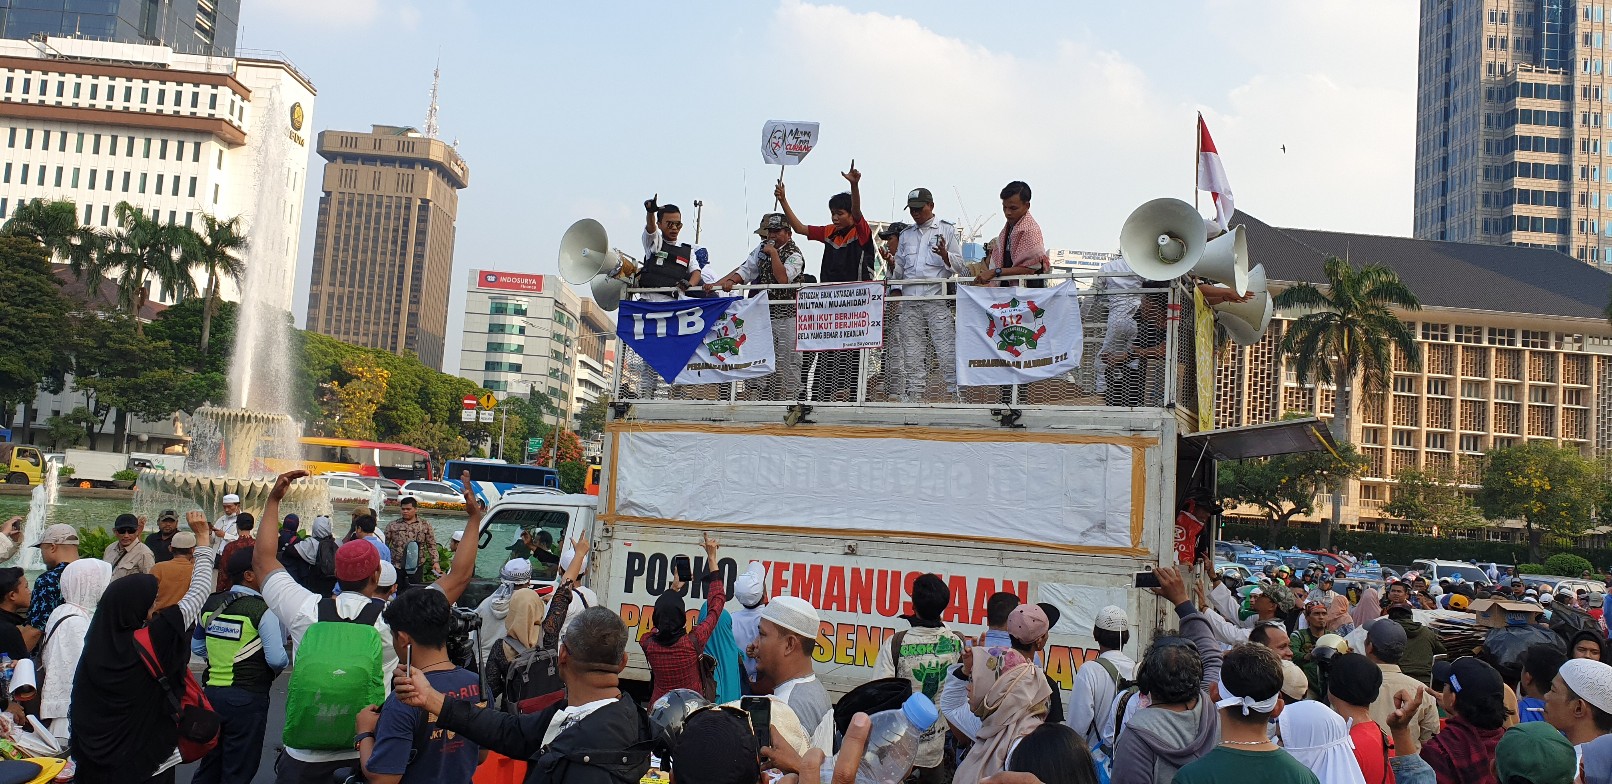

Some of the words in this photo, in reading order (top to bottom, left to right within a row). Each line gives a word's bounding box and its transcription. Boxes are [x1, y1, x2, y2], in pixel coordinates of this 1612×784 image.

[500, 276, 537, 285] INDOSURYA
[798, 301, 824, 309] MILITAN
[828, 298, 867, 309] MUJAHIDAH
[798, 313, 814, 323] KAMI
[816, 313, 833, 322] IKUT
[834, 311, 867, 321] BERJIHAD
[1000, 314, 1022, 327] 212
[633, 306, 706, 340] ITB
[798, 322, 814, 331] KAMI
[816, 321, 833, 330] IKUT
[834, 320, 867, 329] BERJIHAD
[798, 332, 810, 340] BELA
[1022, 356, 1053, 368] ALUMNI
[1054, 352, 1068, 363] 212
